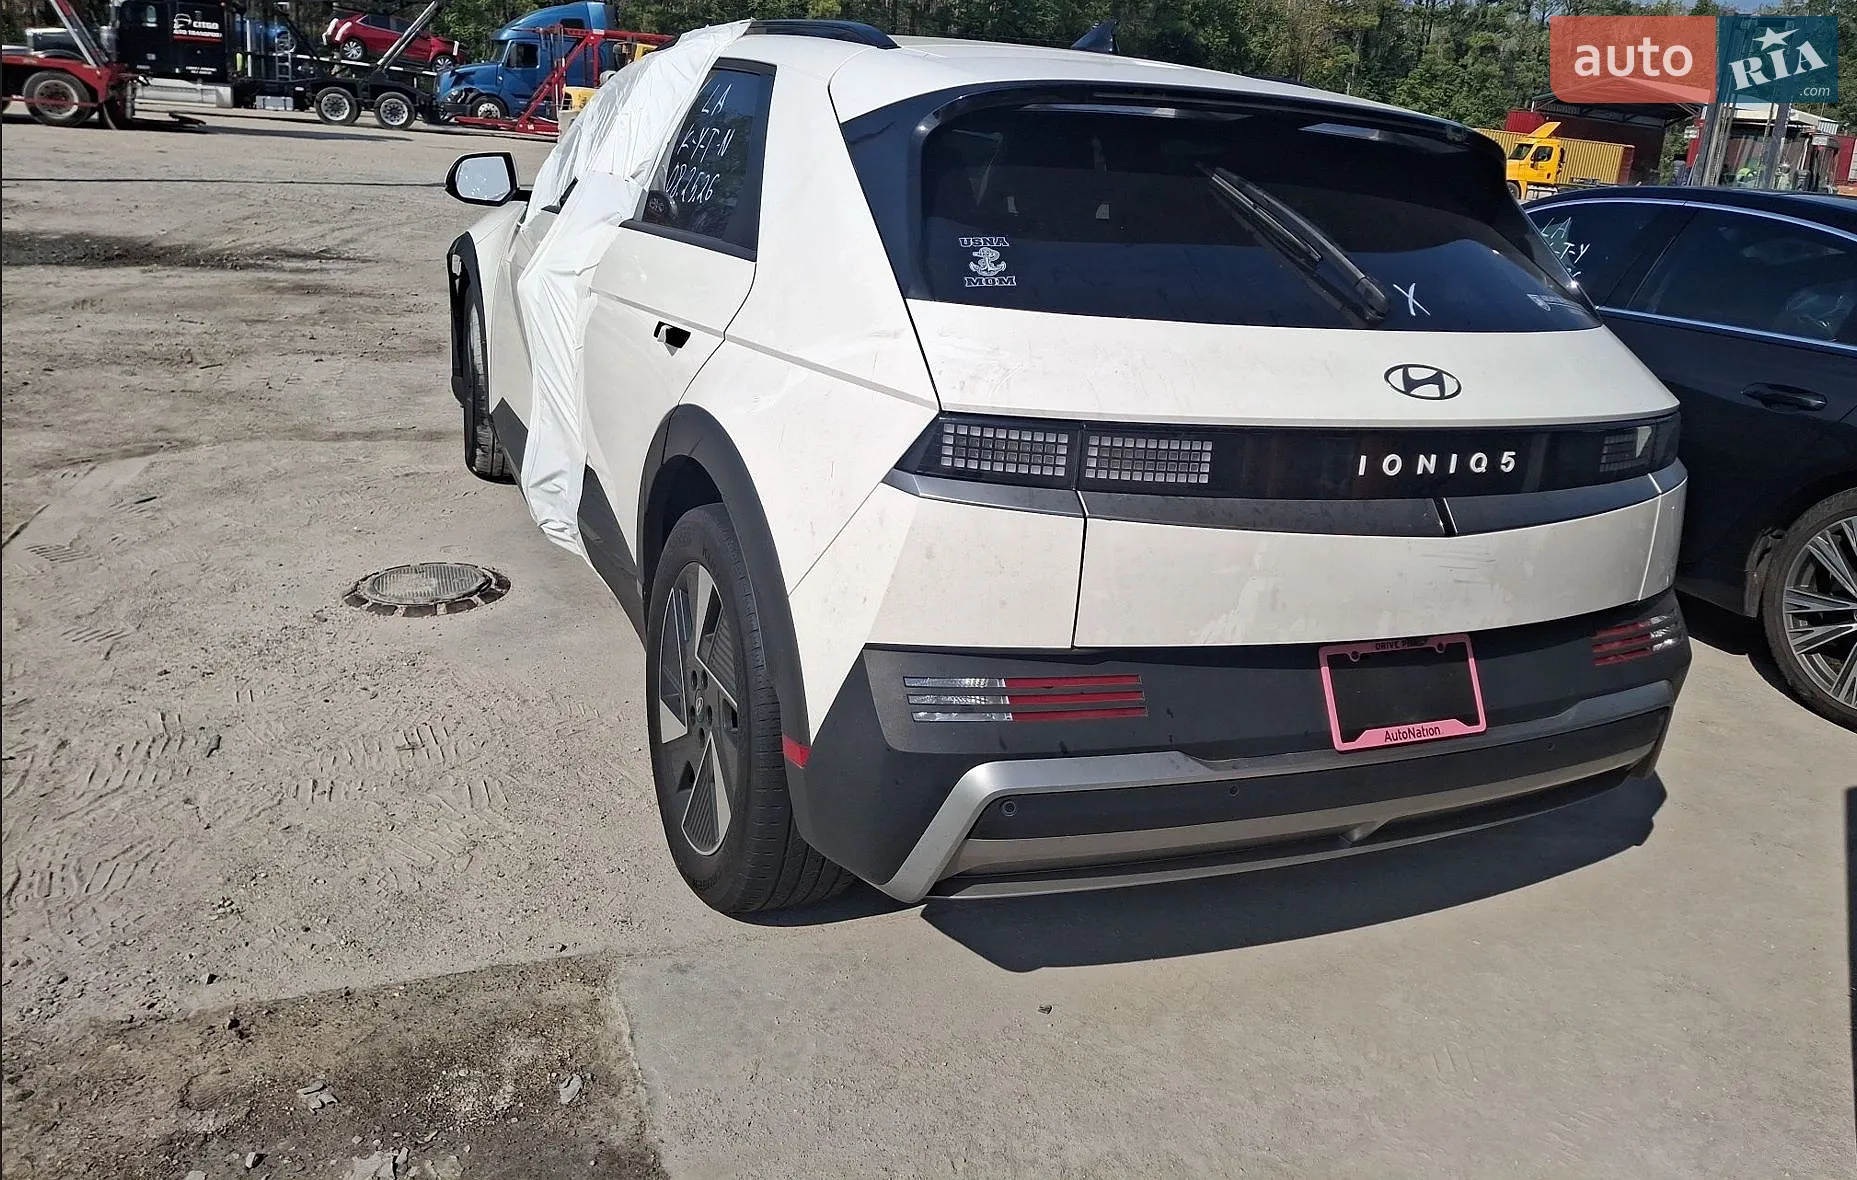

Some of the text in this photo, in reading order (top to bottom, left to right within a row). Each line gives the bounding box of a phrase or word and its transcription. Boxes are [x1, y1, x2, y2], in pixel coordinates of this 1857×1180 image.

[701, 83, 732, 116] LA
[958, 235, 1009, 248] USNA
[964, 275, 1017, 288] MOM
[1384, 725, 1442, 743] AutoNation
